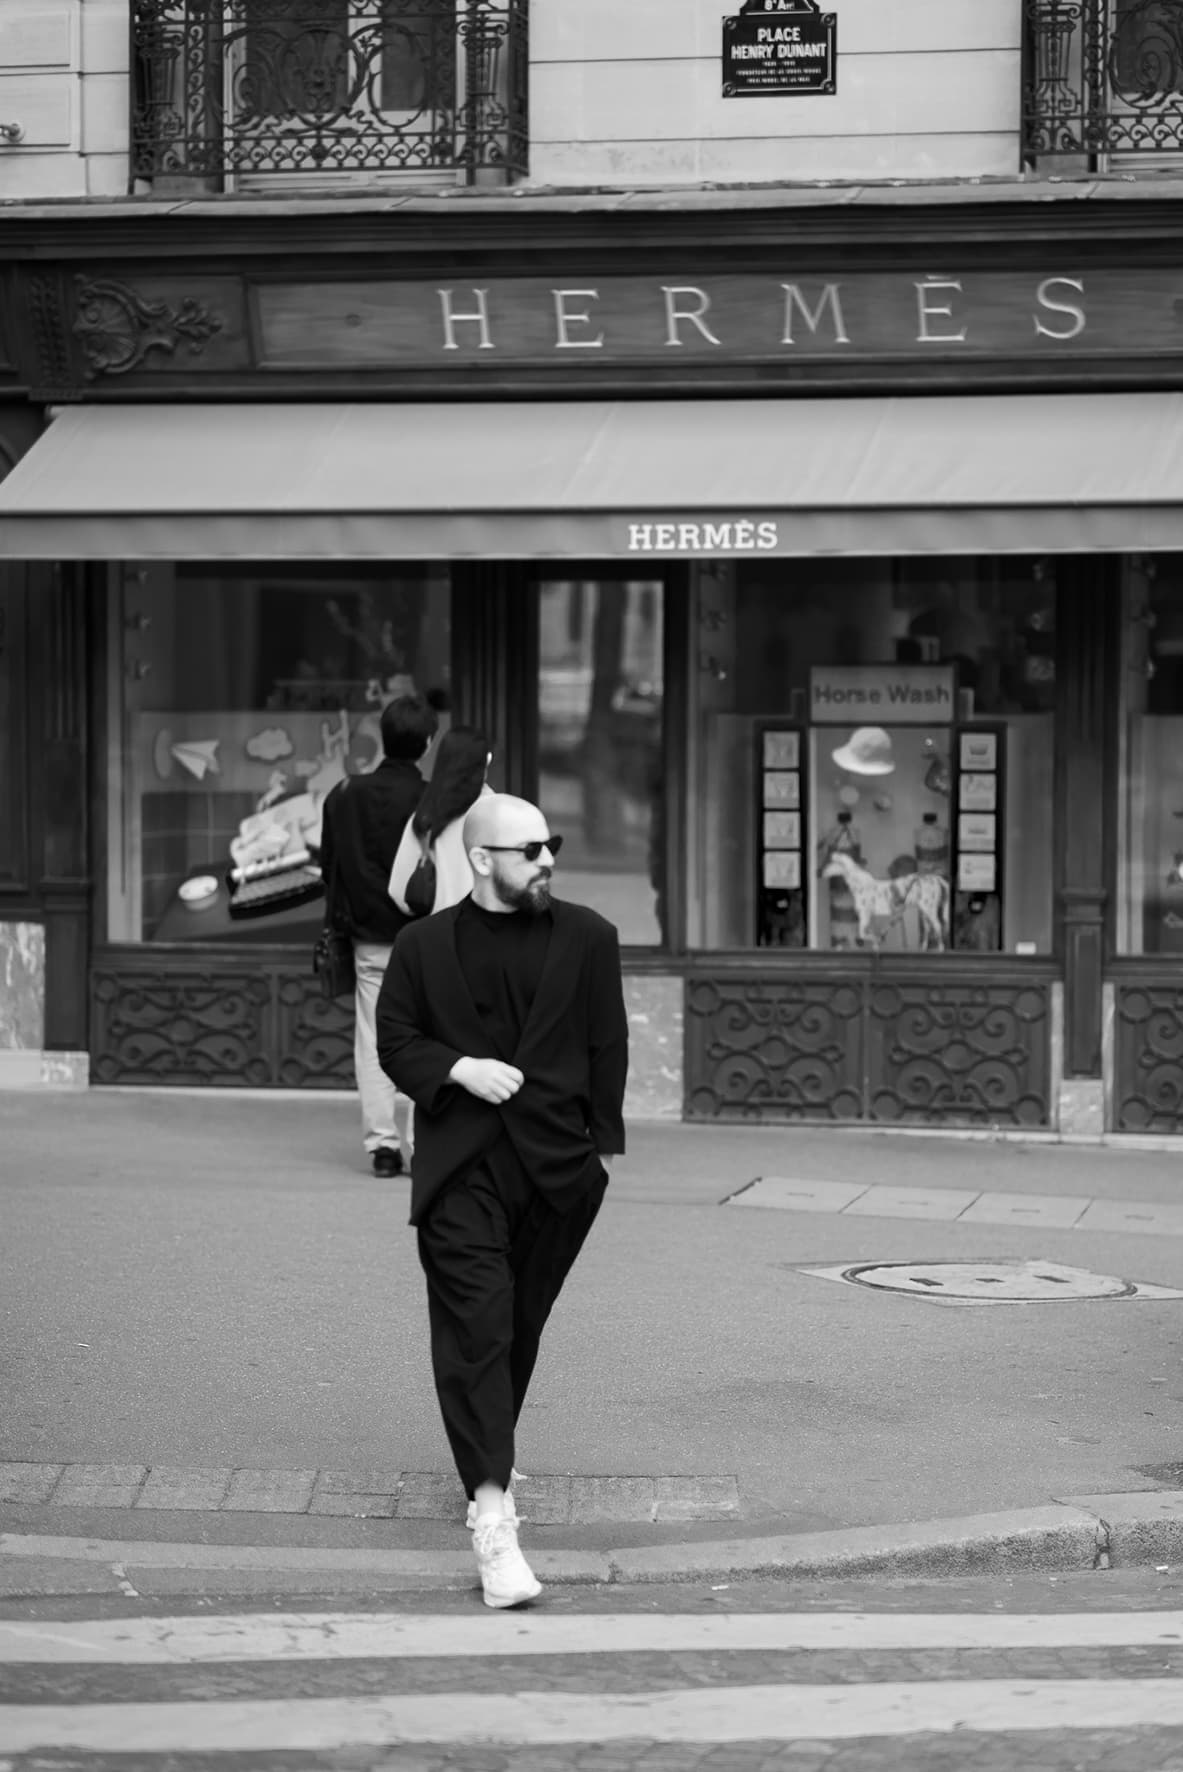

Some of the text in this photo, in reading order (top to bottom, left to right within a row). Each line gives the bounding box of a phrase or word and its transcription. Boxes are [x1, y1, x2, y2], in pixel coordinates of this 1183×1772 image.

[757, 27, 801, 42] PLACE
[731, 43, 827, 60] HENRY DUNANT
[437, 275, 1088, 350] HERMÈS
[628, 519, 779, 551] HERMÈS
[814, 683, 949, 704] Horse Wash
